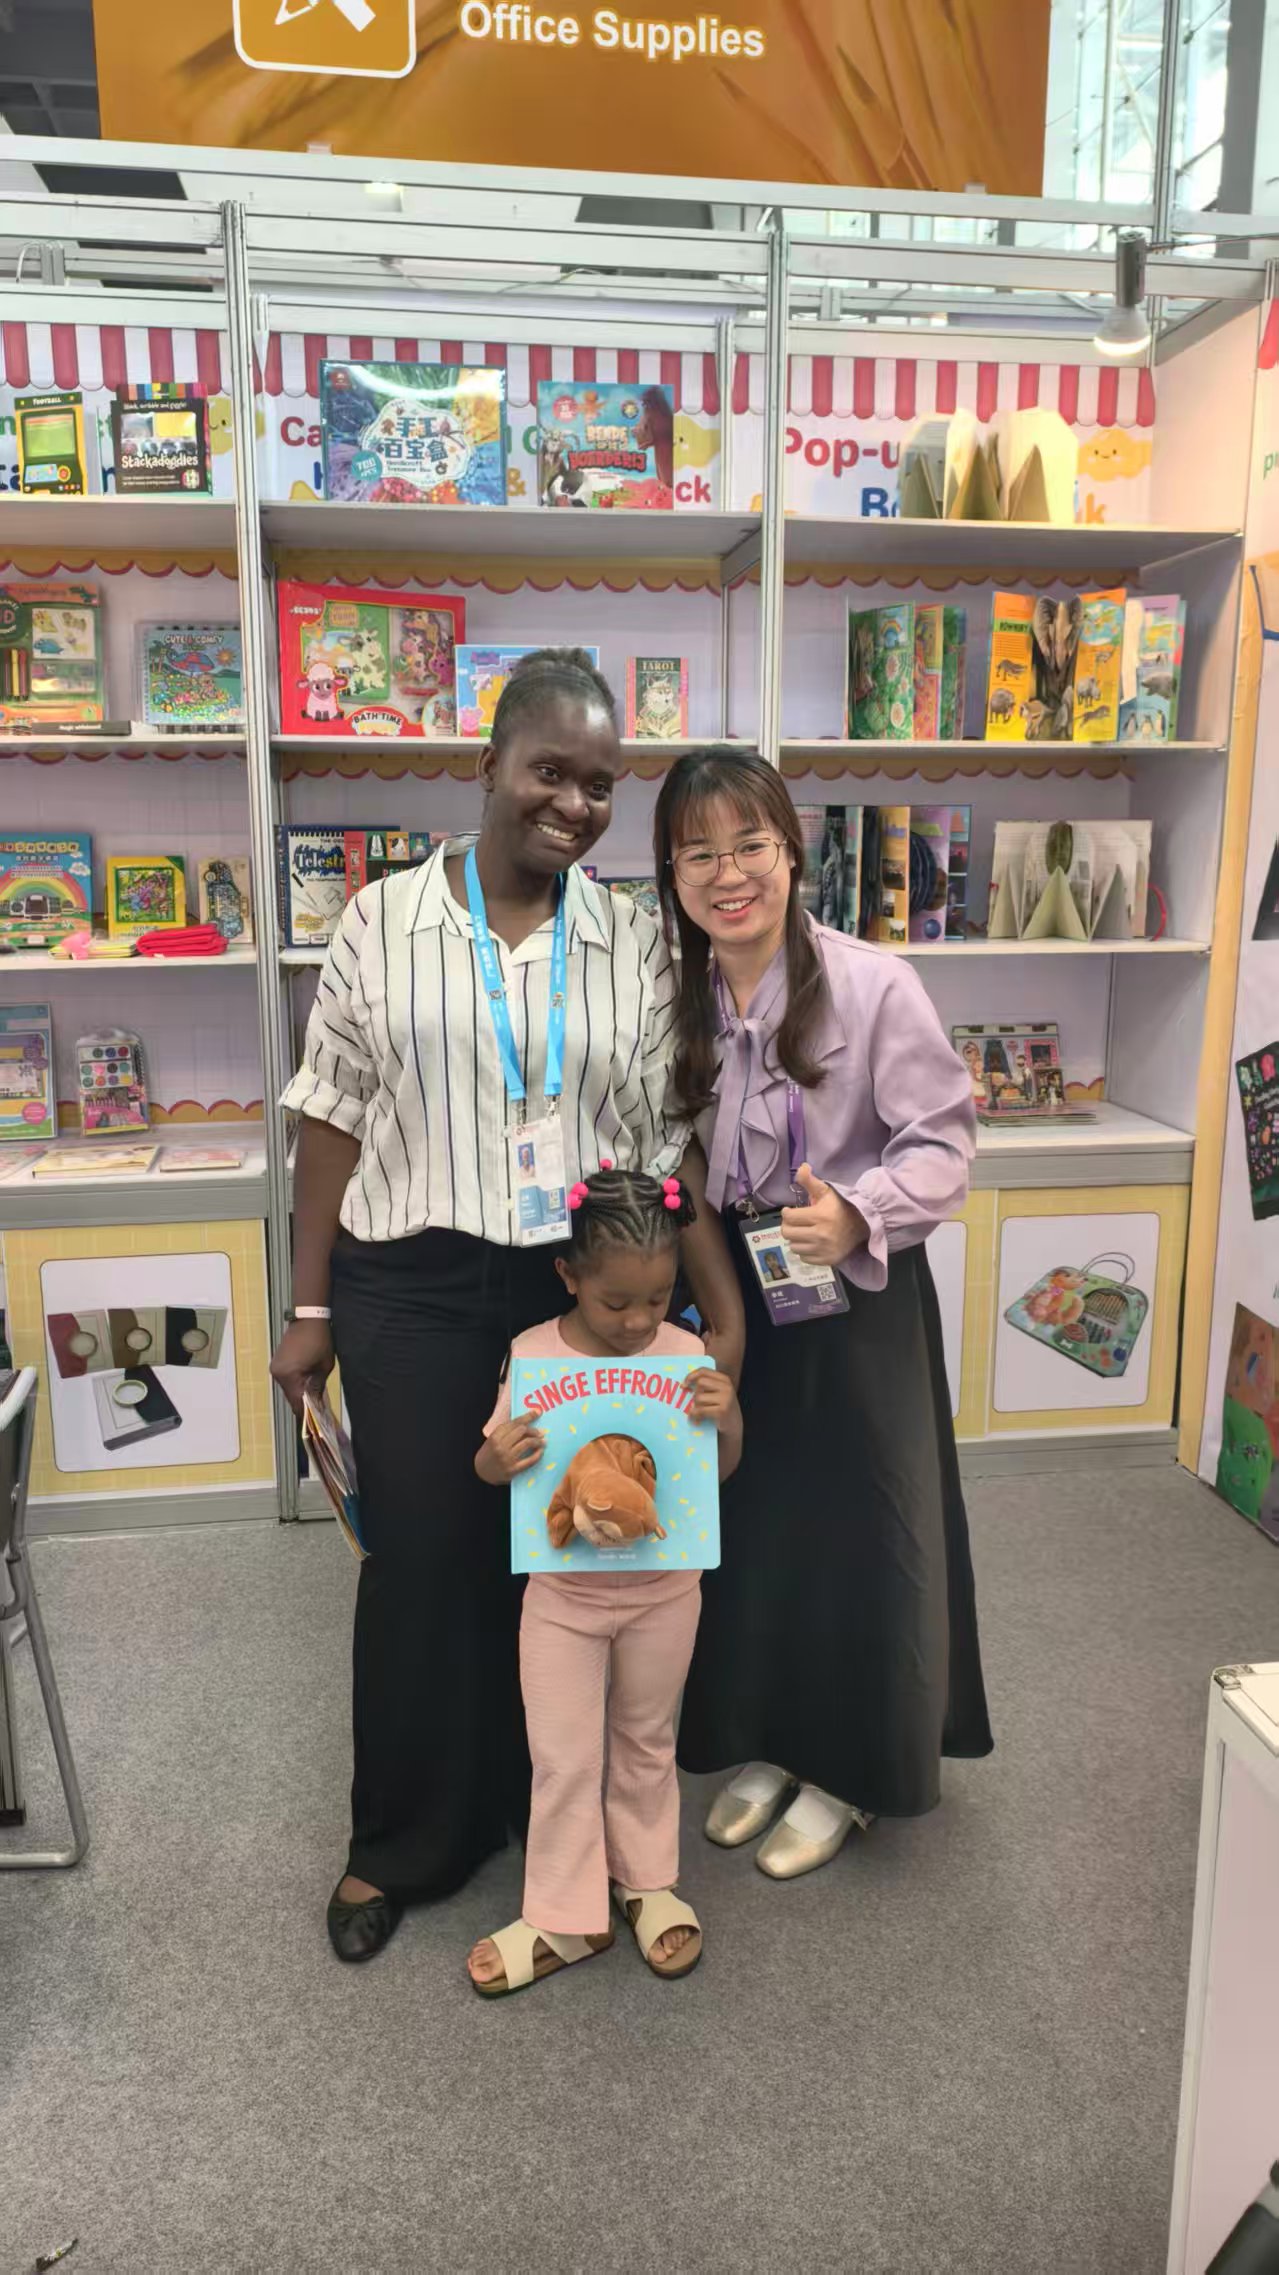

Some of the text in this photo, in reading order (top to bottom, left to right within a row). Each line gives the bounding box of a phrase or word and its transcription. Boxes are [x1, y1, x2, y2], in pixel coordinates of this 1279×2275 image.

[460, 1, 765, 60] Office Supplies
[396, 416, 438, 438] 手工
[384, 438, 448, 462] 百宝盒
[785, 427, 899, 477] Pop-u
[642, 660, 675, 671] TAROT
[353, 712, 402, 726] BATH TIME
[295, 851, 346, 869] Telestr
[523, 1371, 591, 1416] SINGE
